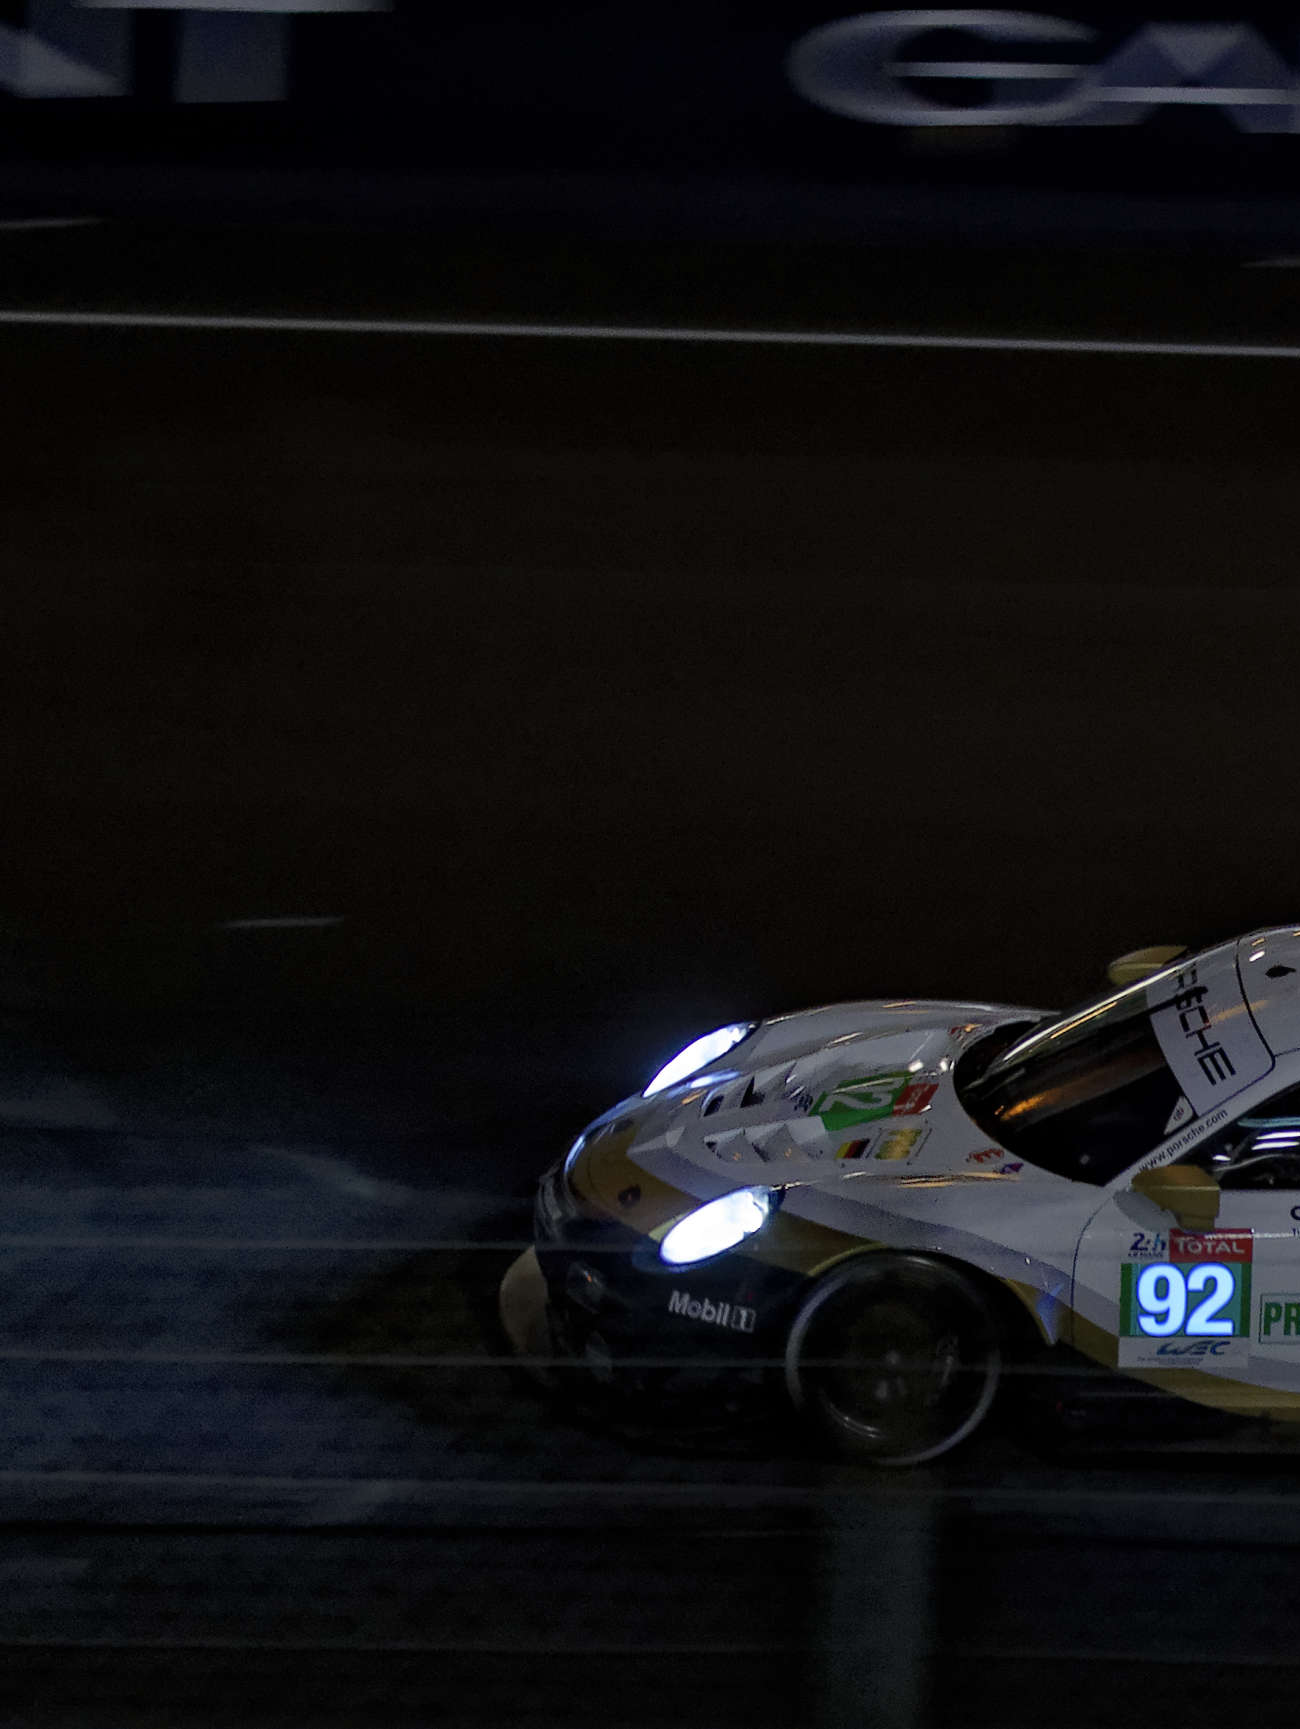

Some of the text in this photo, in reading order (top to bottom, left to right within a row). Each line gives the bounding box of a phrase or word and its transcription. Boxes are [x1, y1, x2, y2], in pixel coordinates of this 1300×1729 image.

[1175, 1238, 1246, 1255] TOTAL
[668, 1290, 731, 1327] Mobil
[1136, 1261, 1236, 1338] 92
